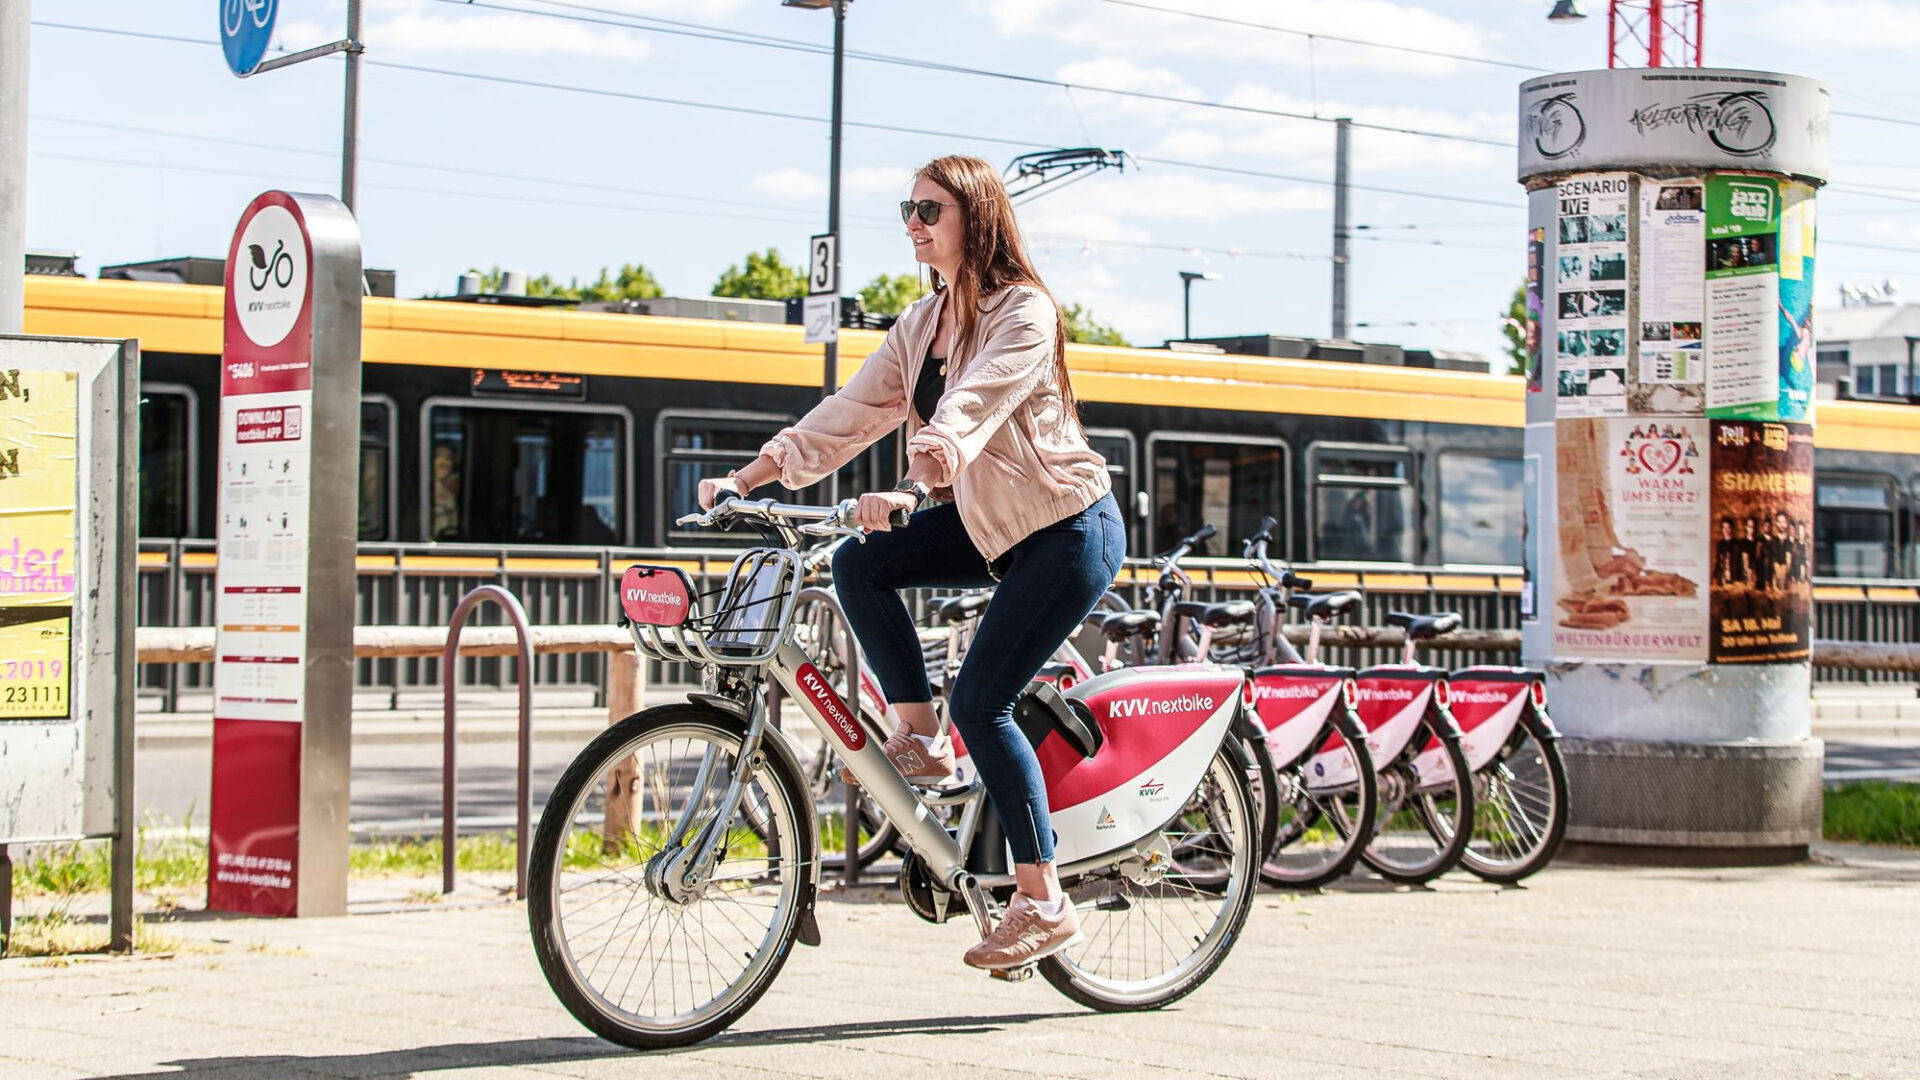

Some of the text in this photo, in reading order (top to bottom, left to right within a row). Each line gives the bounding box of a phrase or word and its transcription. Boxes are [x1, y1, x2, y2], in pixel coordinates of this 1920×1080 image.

[1559, 180, 1627, 197] SCENARIO
[1730, 188, 1767, 205] jazz
[1559, 198, 1588, 215] LIVE
[1730, 203, 1767, 217] club
[816, 241, 829, 288] 3
[238, 409, 283, 426] DOWNLOAD
[1638, 478, 1685, 489] WARM
[1722, 472, 1784, 492] SHAKE
[1622, 490, 1652, 502] UMS
[626, 588, 682, 606] KVV.nextbike
[1554, 631, 1703, 648] WELTENBÜRGERWELT
[6, 686, 62, 703] 23111
[803, 672, 858, 743] KVV.nextbike
[1109, 693, 1214, 719] KVV.nextbike
[896, 749, 926, 774] N
[1139, 788, 1155, 797] KVV
